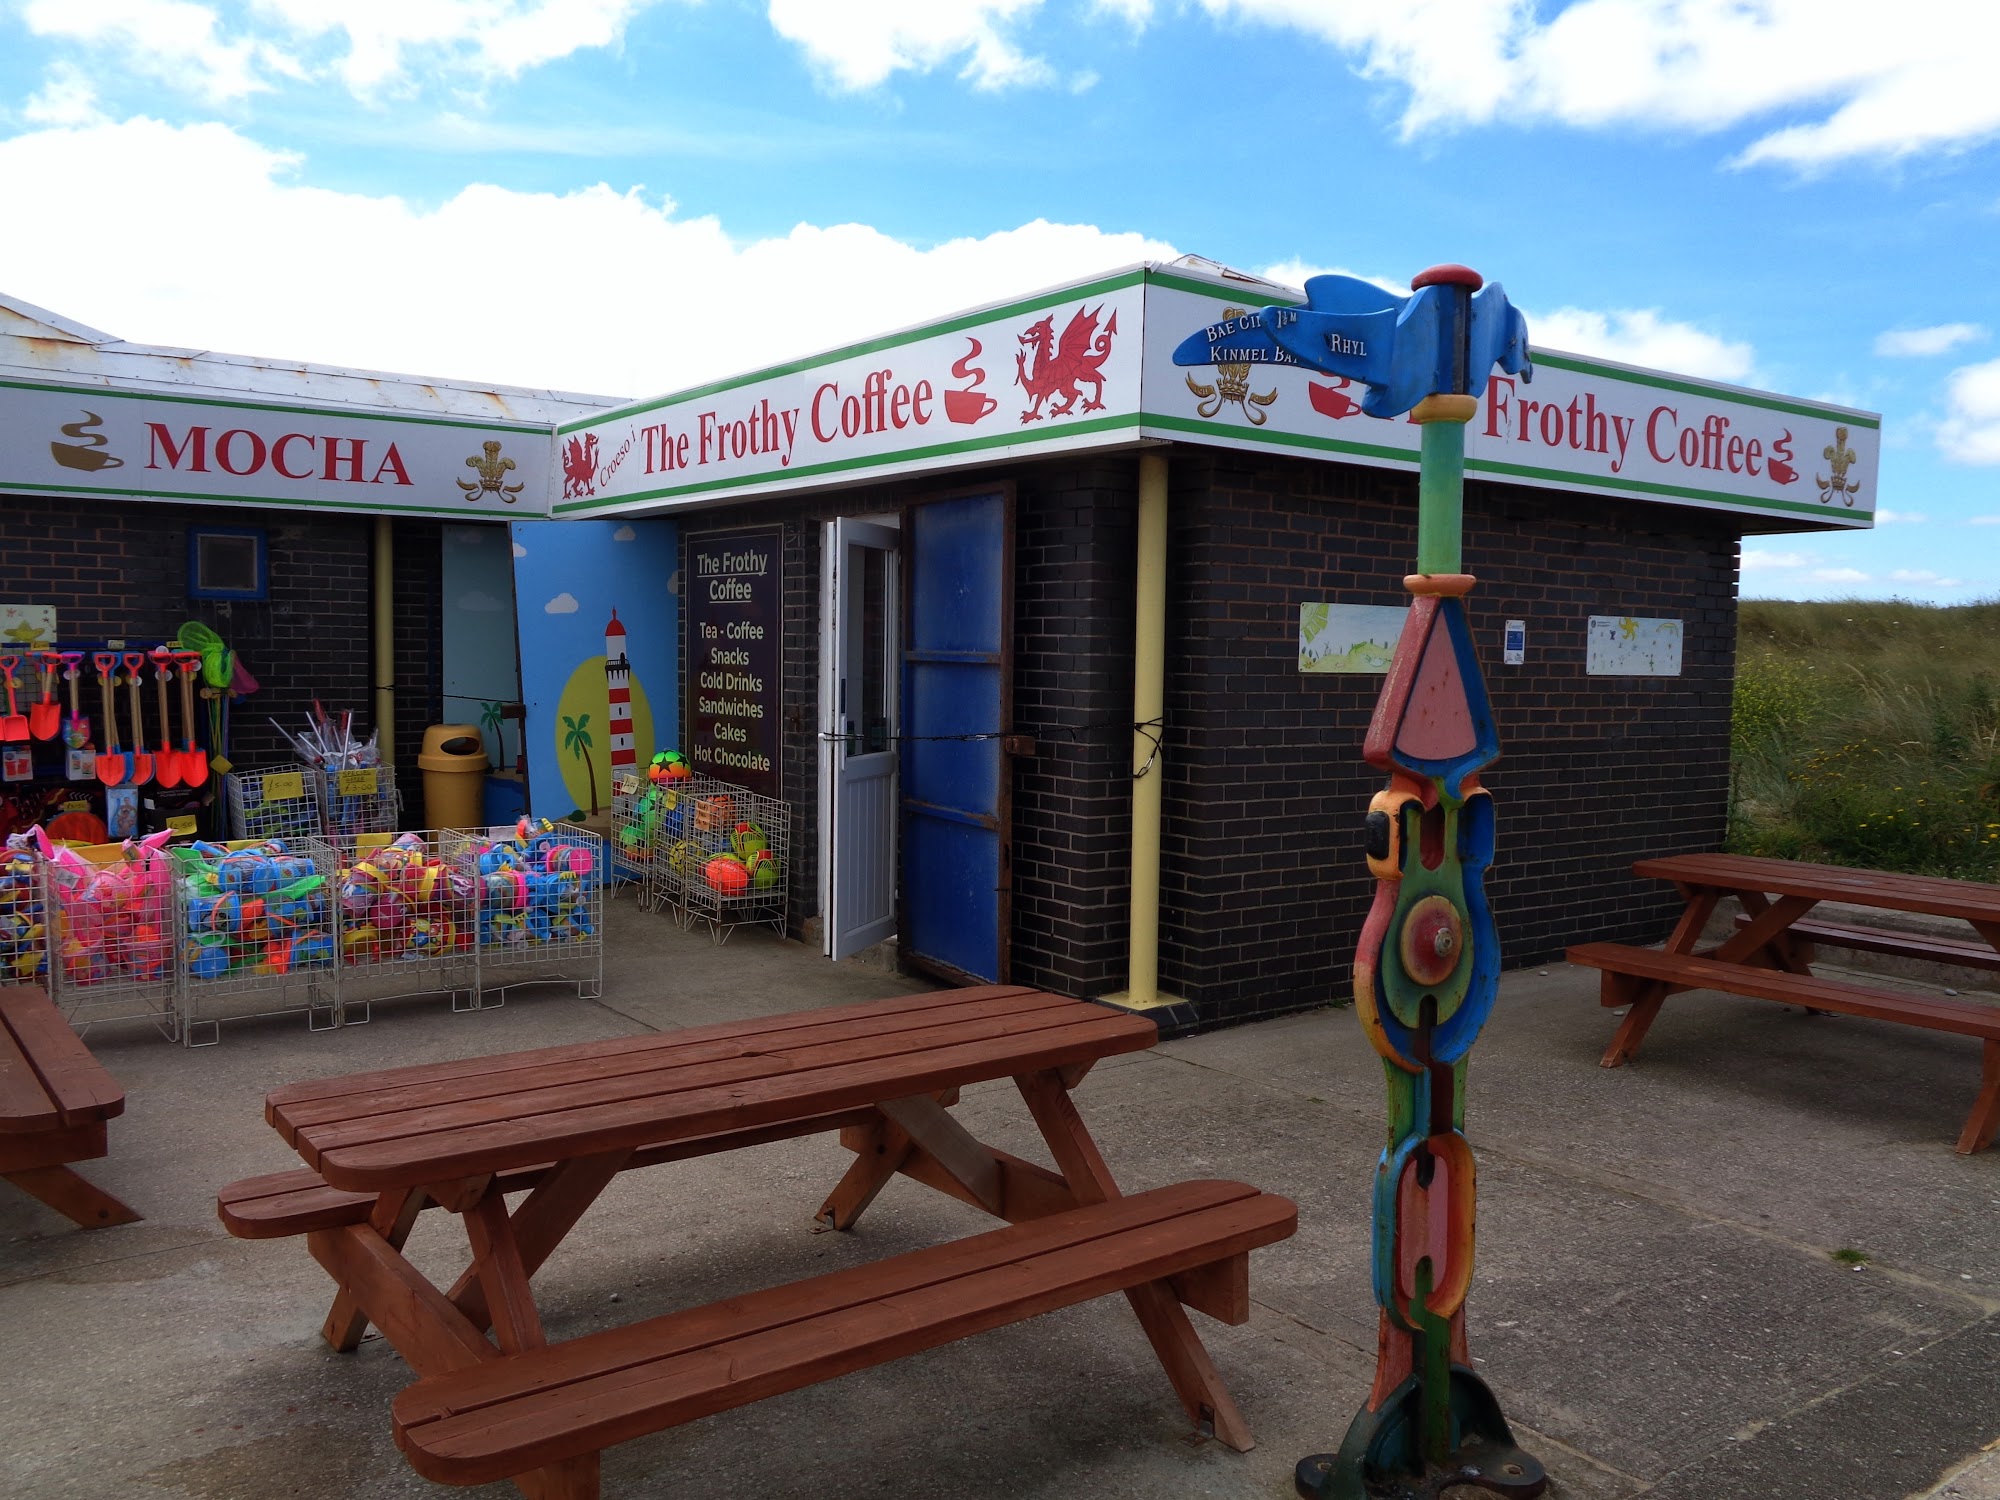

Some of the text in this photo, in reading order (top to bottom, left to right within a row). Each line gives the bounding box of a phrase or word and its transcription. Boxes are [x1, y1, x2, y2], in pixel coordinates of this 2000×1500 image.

[1206, 321, 1236, 343] BAE
[1210, 346, 1269, 362] KINMEL
[1331, 333, 1368, 357] RHYL
[640, 368, 933, 475] The Frothy Coffee
[1482, 374, 1763, 477] Frothy Coffee
[144, 421, 415, 486] MOCHA
[600, 438, 631, 487] Croeso
[697, 549, 768, 577] The Frothy
[709, 578, 752, 601] Coffee
[700, 621, 718, 639] Tea
[726, 620, 764, 640] Coffee
[711, 646, 750, 666] Snacks
[700, 671, 763, 693] Cold Drinks
[699, 695, 764, 719] Sandwiches
[714, 722, 747, 743] Cakes
[694, 744, 771, 772] Hot Chocolate
